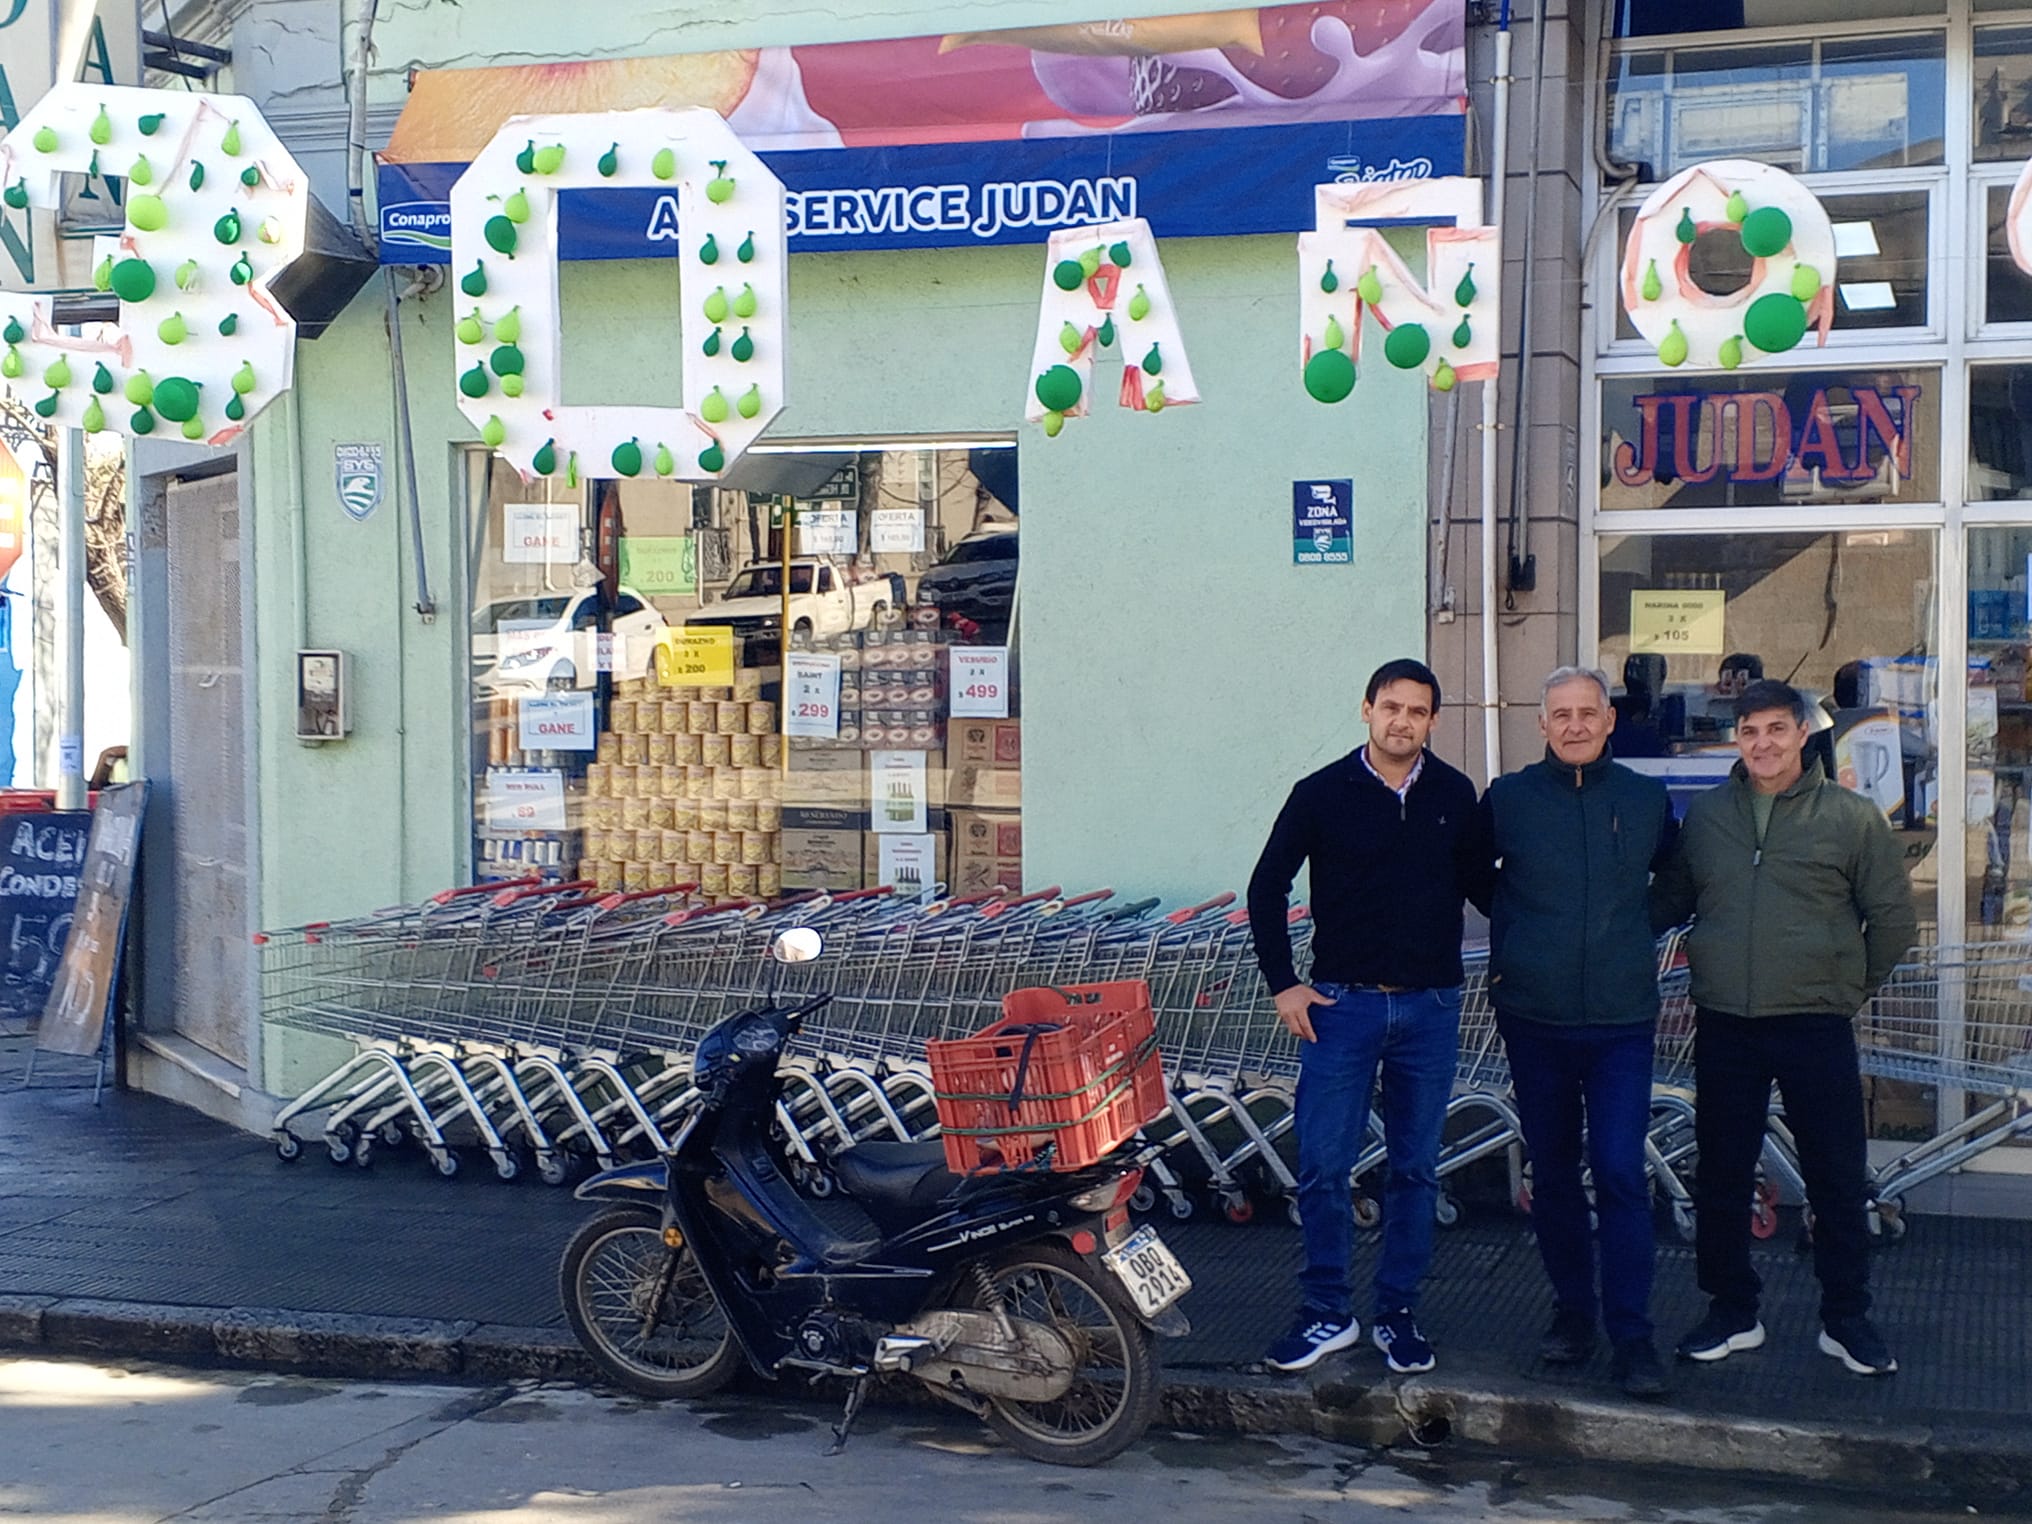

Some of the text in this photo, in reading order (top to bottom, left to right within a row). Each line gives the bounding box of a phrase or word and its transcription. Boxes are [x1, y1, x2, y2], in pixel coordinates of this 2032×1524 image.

[785, 176, 1137, 237] SERVICE JUDAN
[1615, 386, 1921, 486] JUDAN
[878, 511, 915, 521] OFERTA
[1307, 506, 1338, 518] ZONA
[646, 571, 674, 583] 200
[1664, 630, 1689, 641] 105
[685, 664, 706, 674] 200
[966, 684, 998, 698] 499
[798, 703, 829, 718] 299
[538, 723, 575, 735] GANE
[1139, 1264, 1185, 1307] 2914
